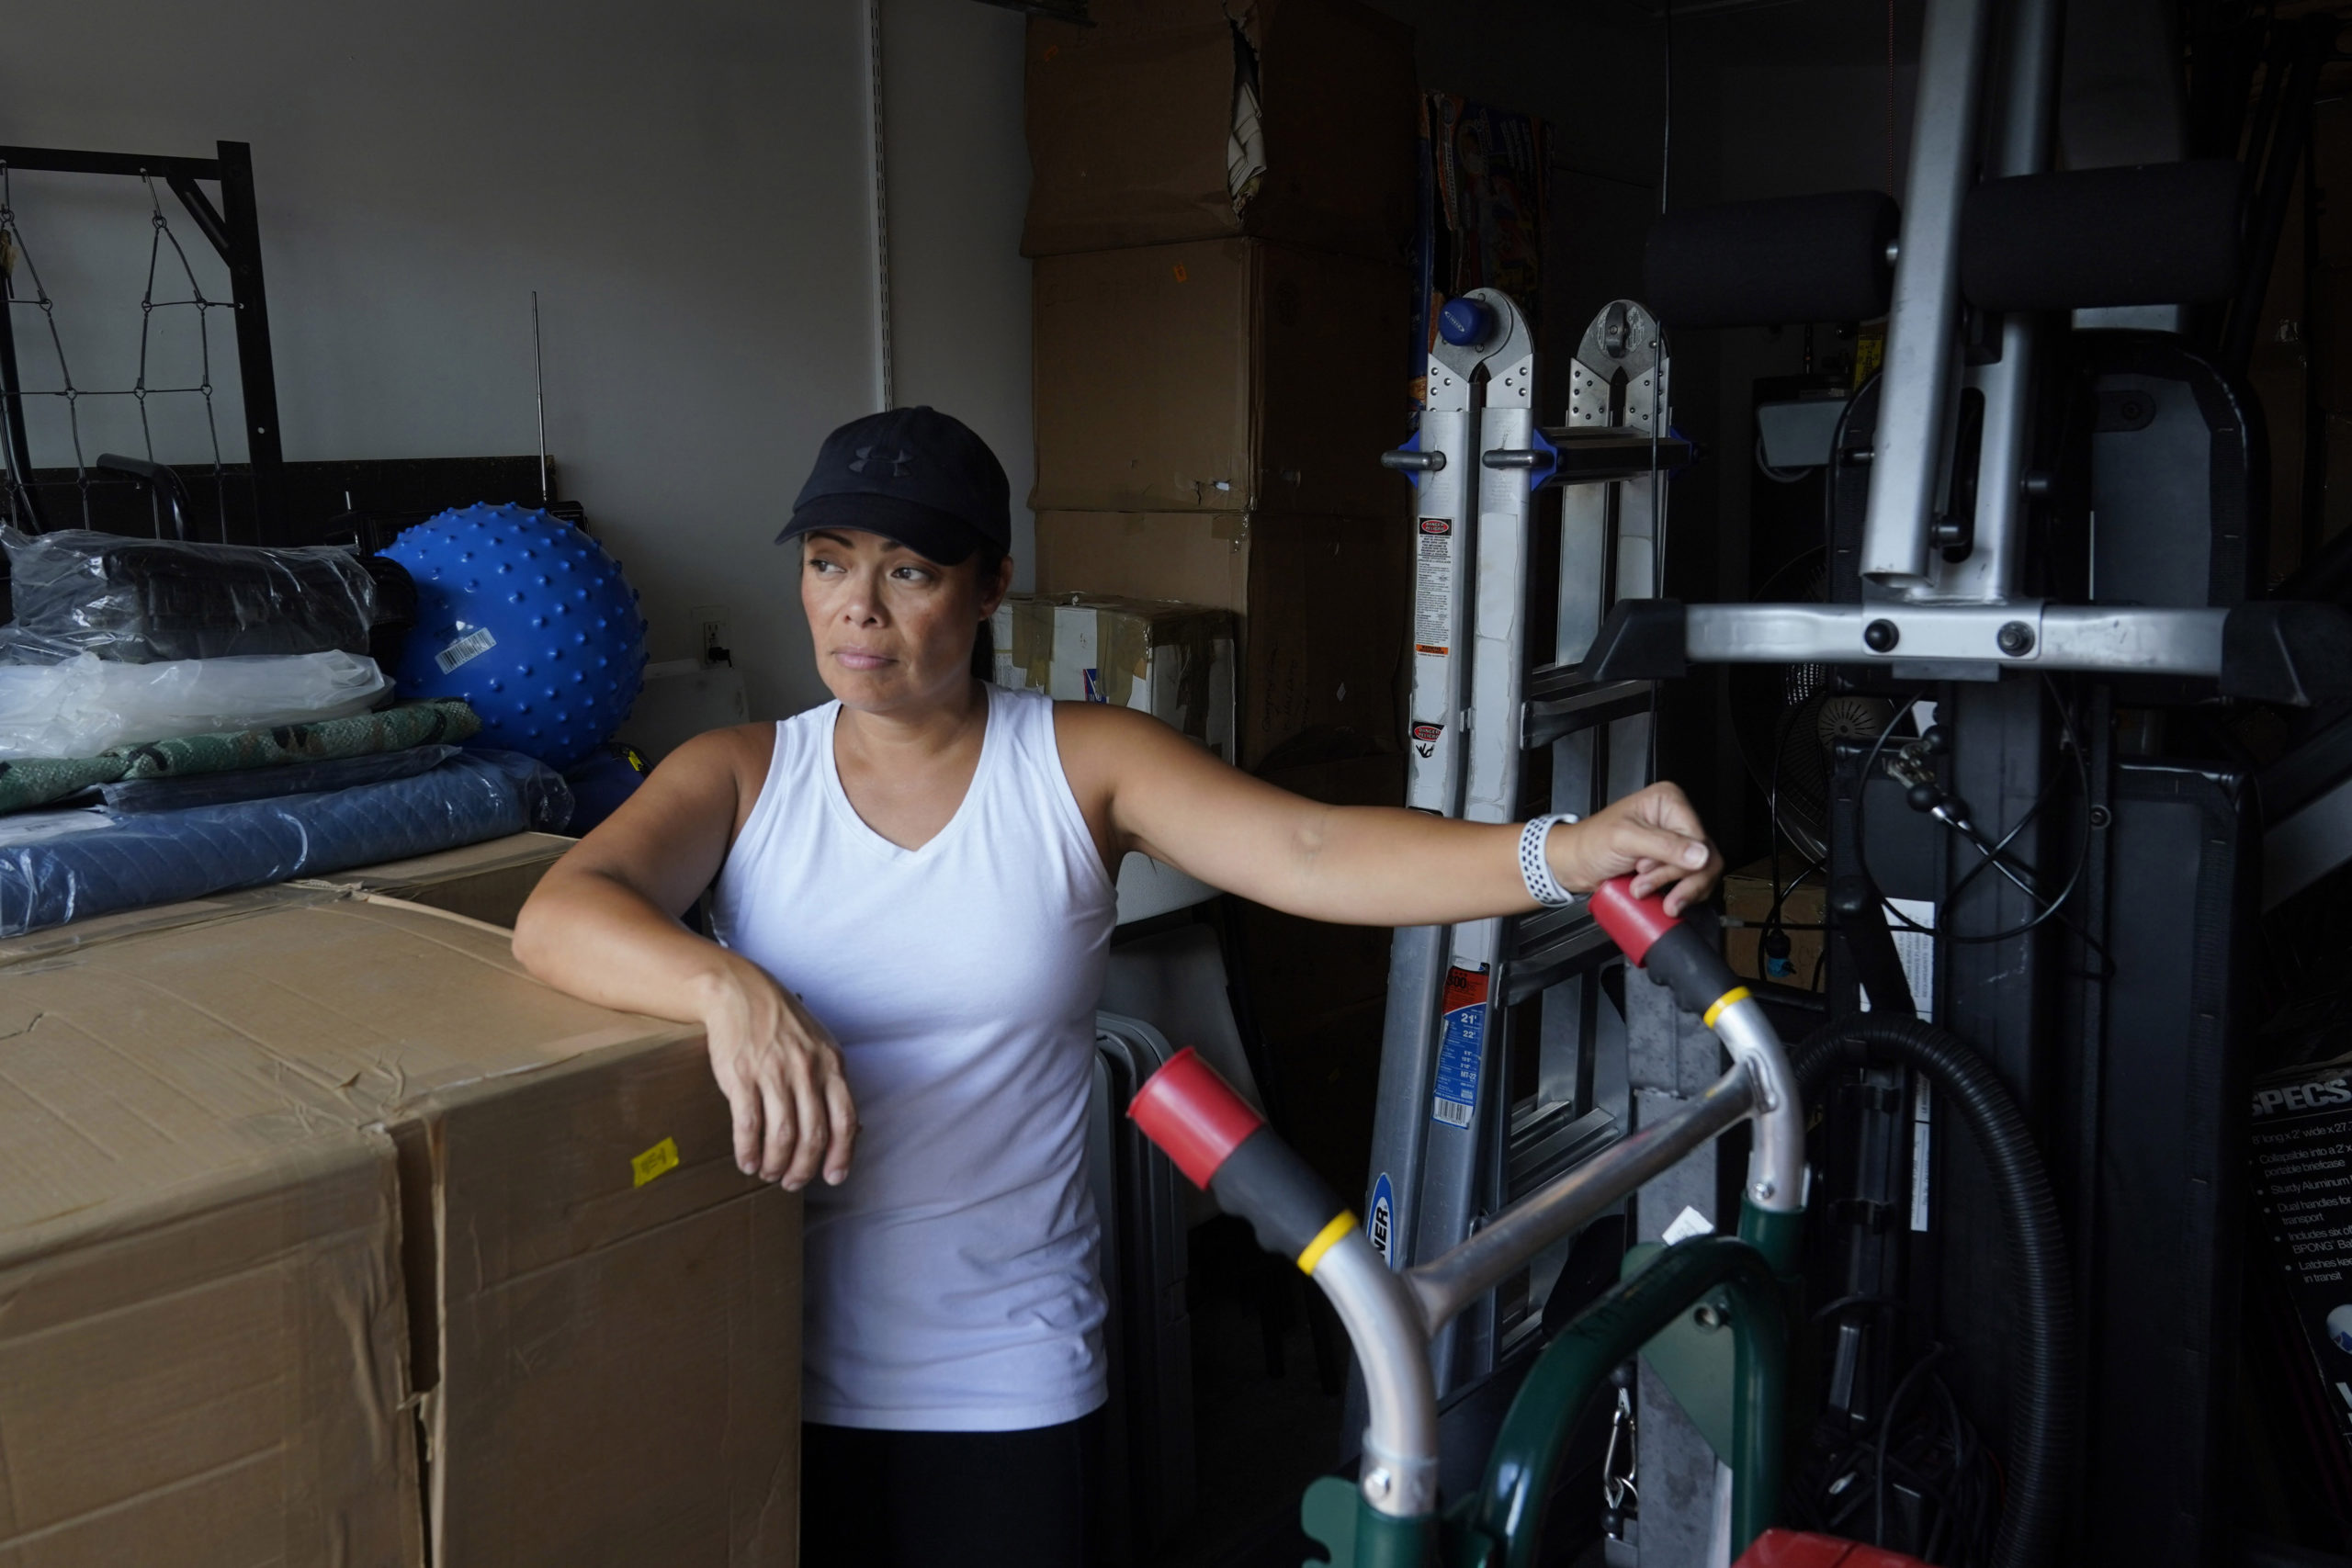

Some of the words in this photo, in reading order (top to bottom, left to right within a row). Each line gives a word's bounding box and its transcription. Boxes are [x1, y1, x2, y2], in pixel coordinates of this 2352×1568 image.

[1460, 1012, 1477, 1025] 21'
[1461, 1070, 1477, 1080] MT-22
[2262, 1133, 2285, 1145] long
[2302, 1124, 2326, 1138] wide
[2327, 1126, 2335, 1134] x
[2309, 1147, 2328, 1157] into
[2328, 1147, 2335, 1156] a
[2301, 1158, 2346, 1172] briefcase
[2270, 1183, 2301, 1195] Sturdy
[2302, 1177, 2350, 1190] Aluminum
[2278, 1201, 2301, 1213] Dual
[2301, 1197, 2339, 1209] handles
[2338, 1195, 2352, 1205] for
[2281, 1212, 2325, 1225] transport
[2287, 1229, 2328, 1241] Includes
[2328, 1227, 2343, 1237] six
[2298, 1258, 2337, 1270] Latches
[2303, 1274, 2313, 1284] in
[2312, 1270, 2344, 1283] transit
